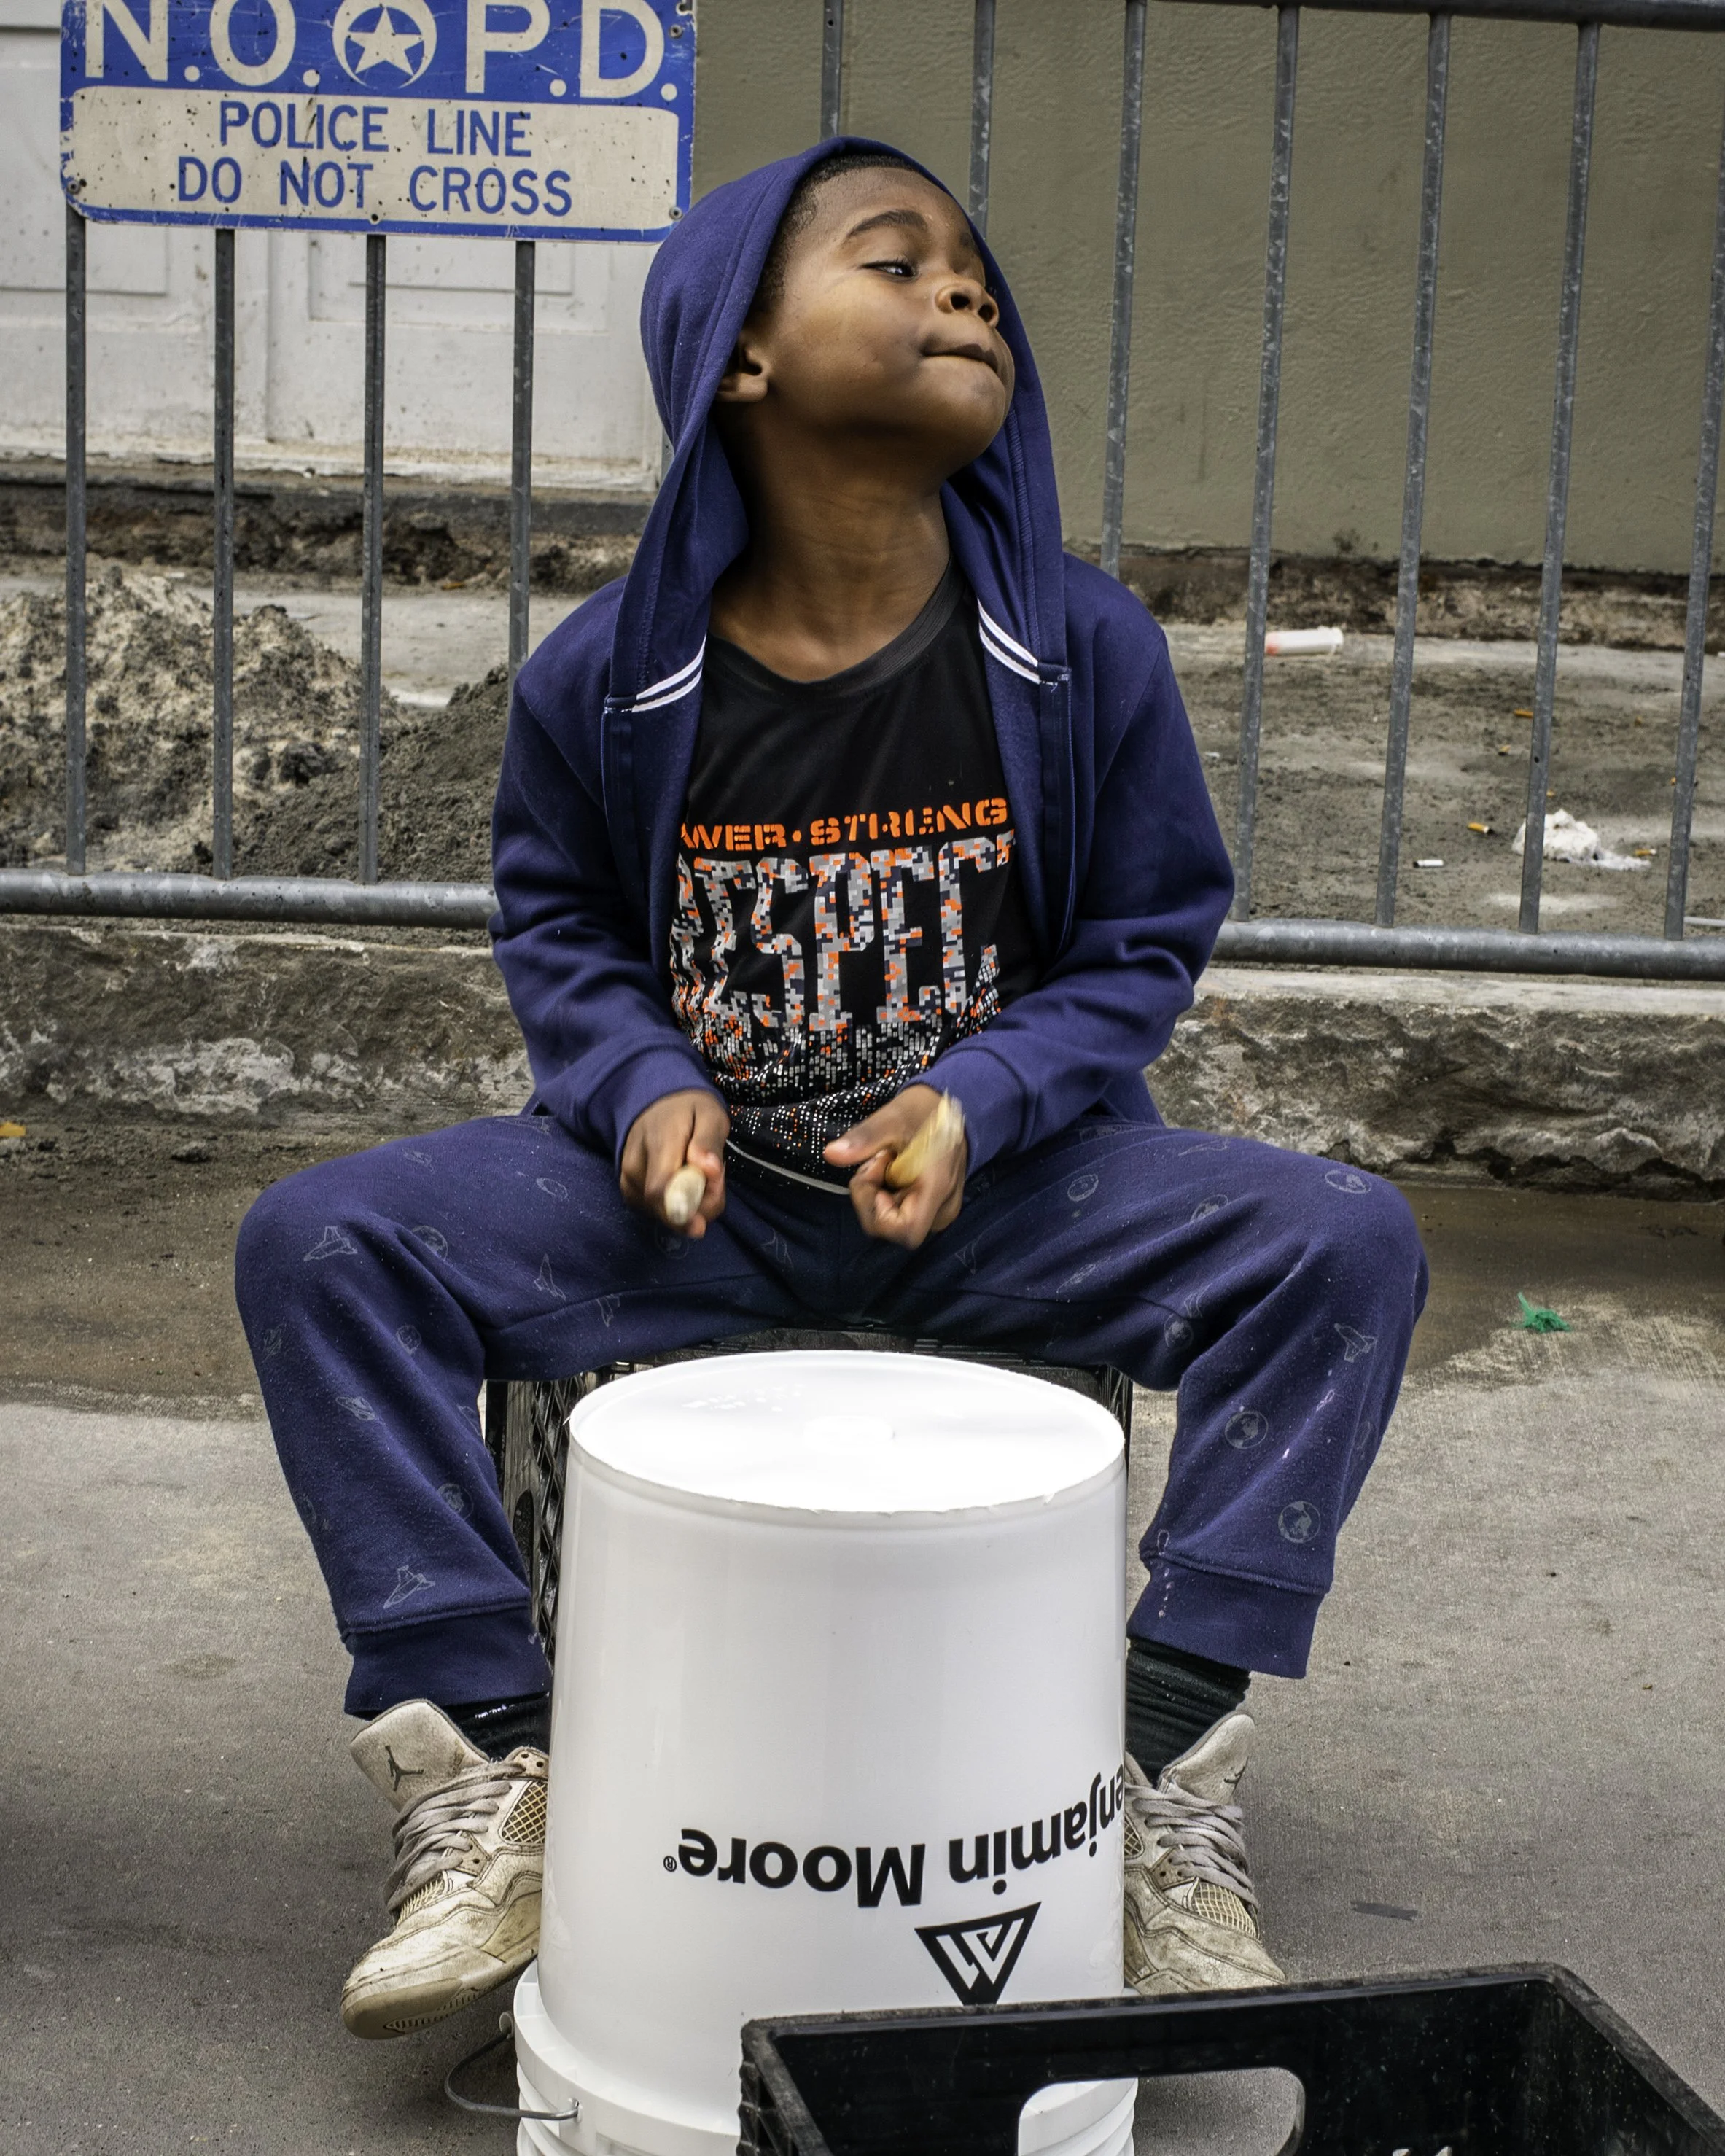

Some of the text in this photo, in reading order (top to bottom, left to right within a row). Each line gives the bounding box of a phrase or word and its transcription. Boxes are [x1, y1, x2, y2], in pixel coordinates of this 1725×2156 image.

[220, 101, 531, 158] POLICE LINE
[178, 155, 572, 217] DO NOT CROSS
